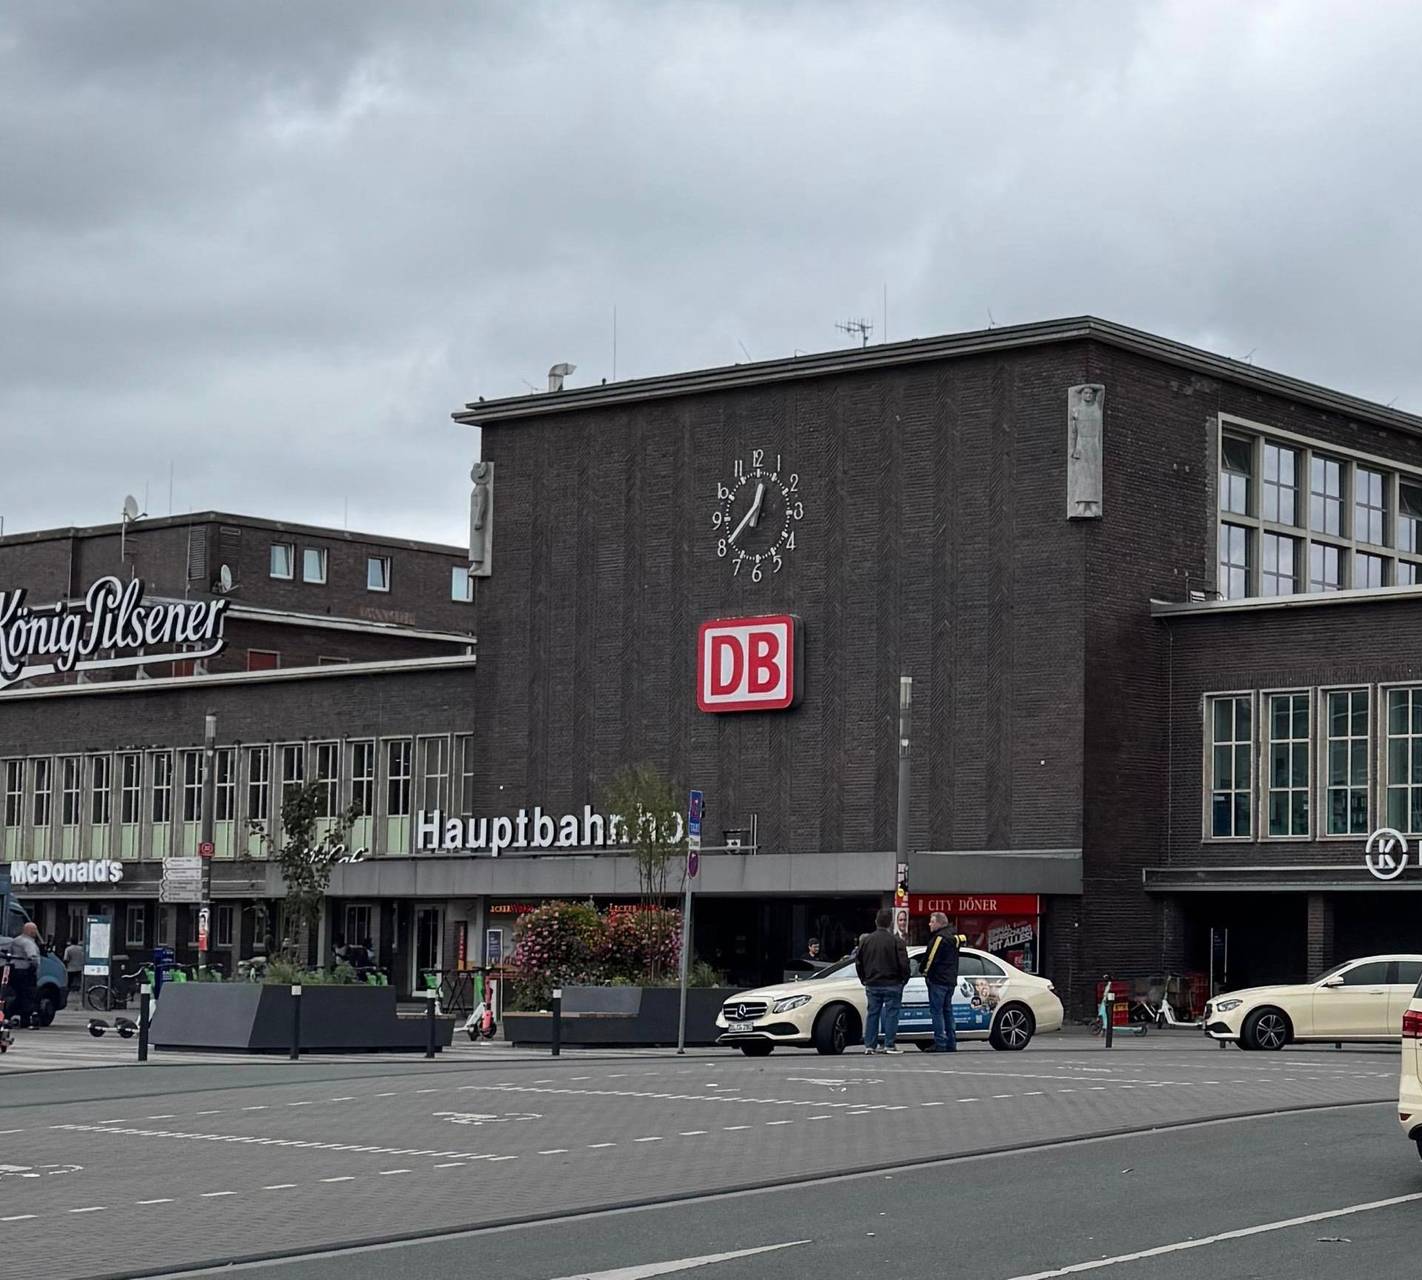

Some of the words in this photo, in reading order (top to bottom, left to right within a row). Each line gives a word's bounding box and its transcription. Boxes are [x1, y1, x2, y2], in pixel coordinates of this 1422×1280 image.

[752, 450, 763, 467] 12
[734, 460, 742, 477] 11
[717, 483, 729, 499] 10
[790, 474, 798, 492] 2
[793, 502, 803, 520] 3
[712, 512, 721, 530] 9
[717, 540, 727, 557] 8
[786, 532, 796, 551] 4
[733, 559, 740, 576] 7
[752, 564, 762, 582] 6
[773, 556, 782, 573] 5
[78, 575, 225, 654] Pilsener
[710, 632, 781, 696] DB
[417, 804, 690, 857] Hauptbahnho
[11, 860, 123, 884] McDonald's
[928, 900, 952, 911] CITY
[959, 897, 997, 911] DÖNER
